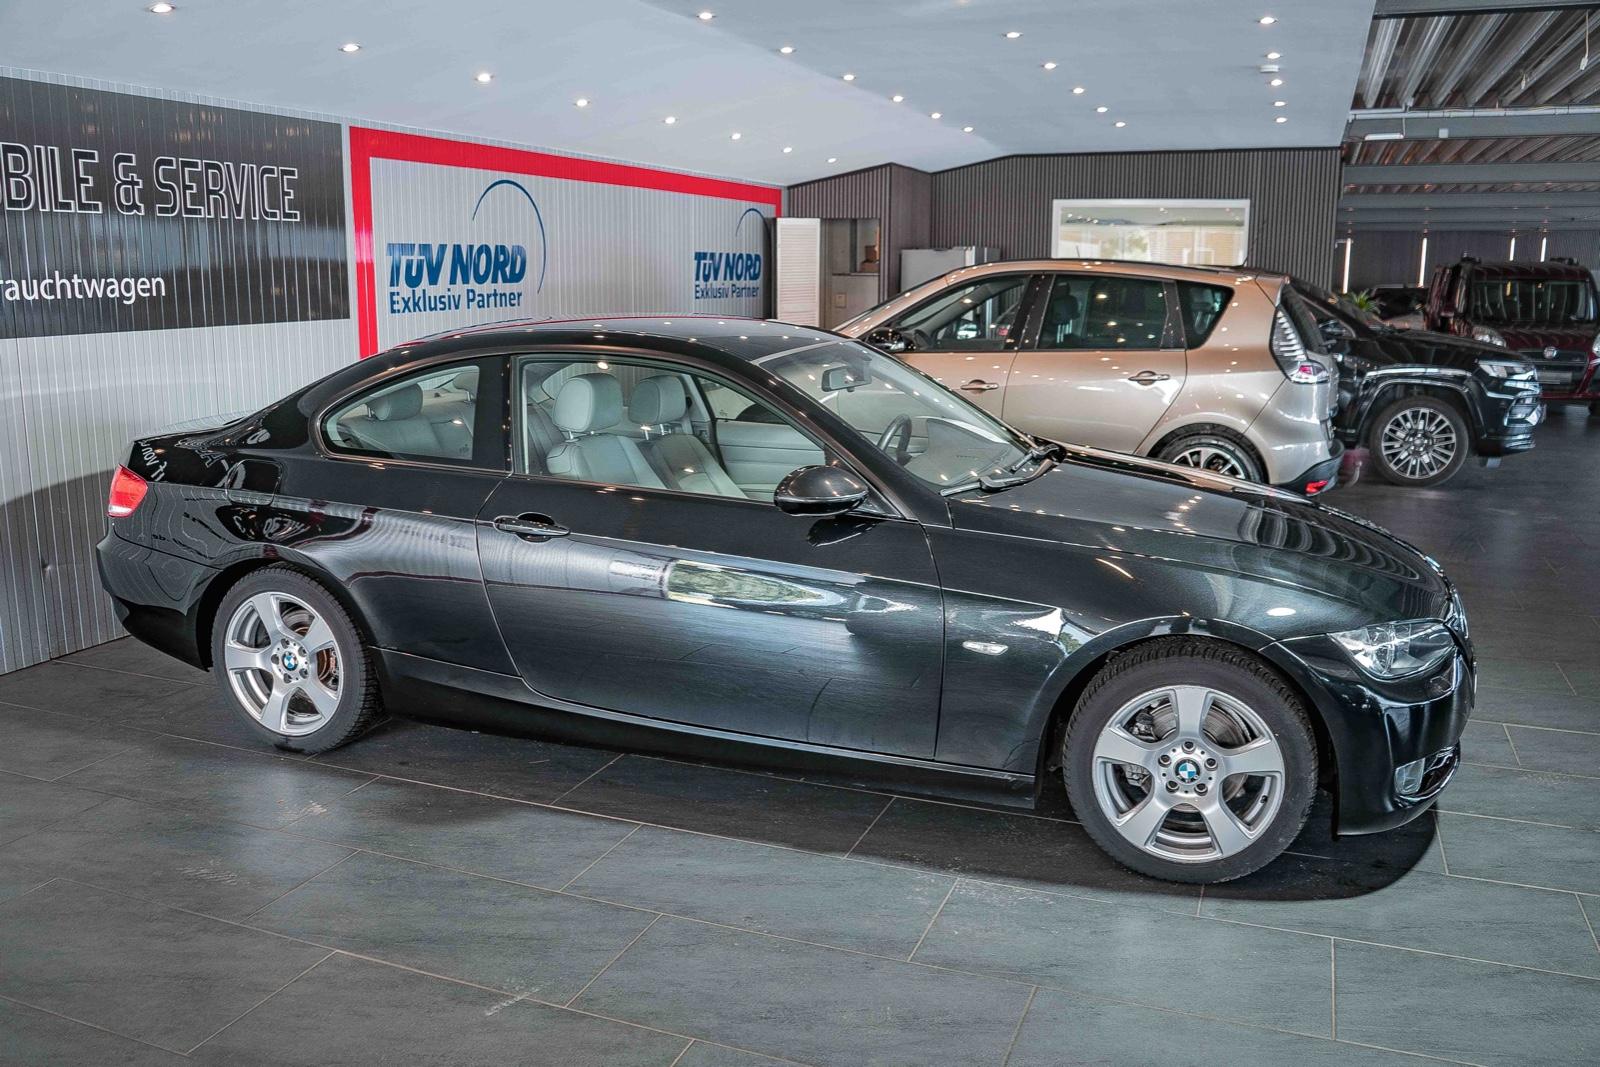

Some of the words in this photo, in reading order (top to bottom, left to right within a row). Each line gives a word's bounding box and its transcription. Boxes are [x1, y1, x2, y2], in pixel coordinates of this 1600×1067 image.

[0, 141, 103, 214] BILE
[112, 152, 145, 216] &
[153, 156, 300, 222] SERVICE
[449, 243, 527, 286] NORD
[723, 252, 762, 282] NORD
[389, 287, 461, 314] Exklusiv
[466, 288, 522, 310] Partner
[695, 282, 730, 300] Exklusiv
[731, 283, 760, 299] Partner
